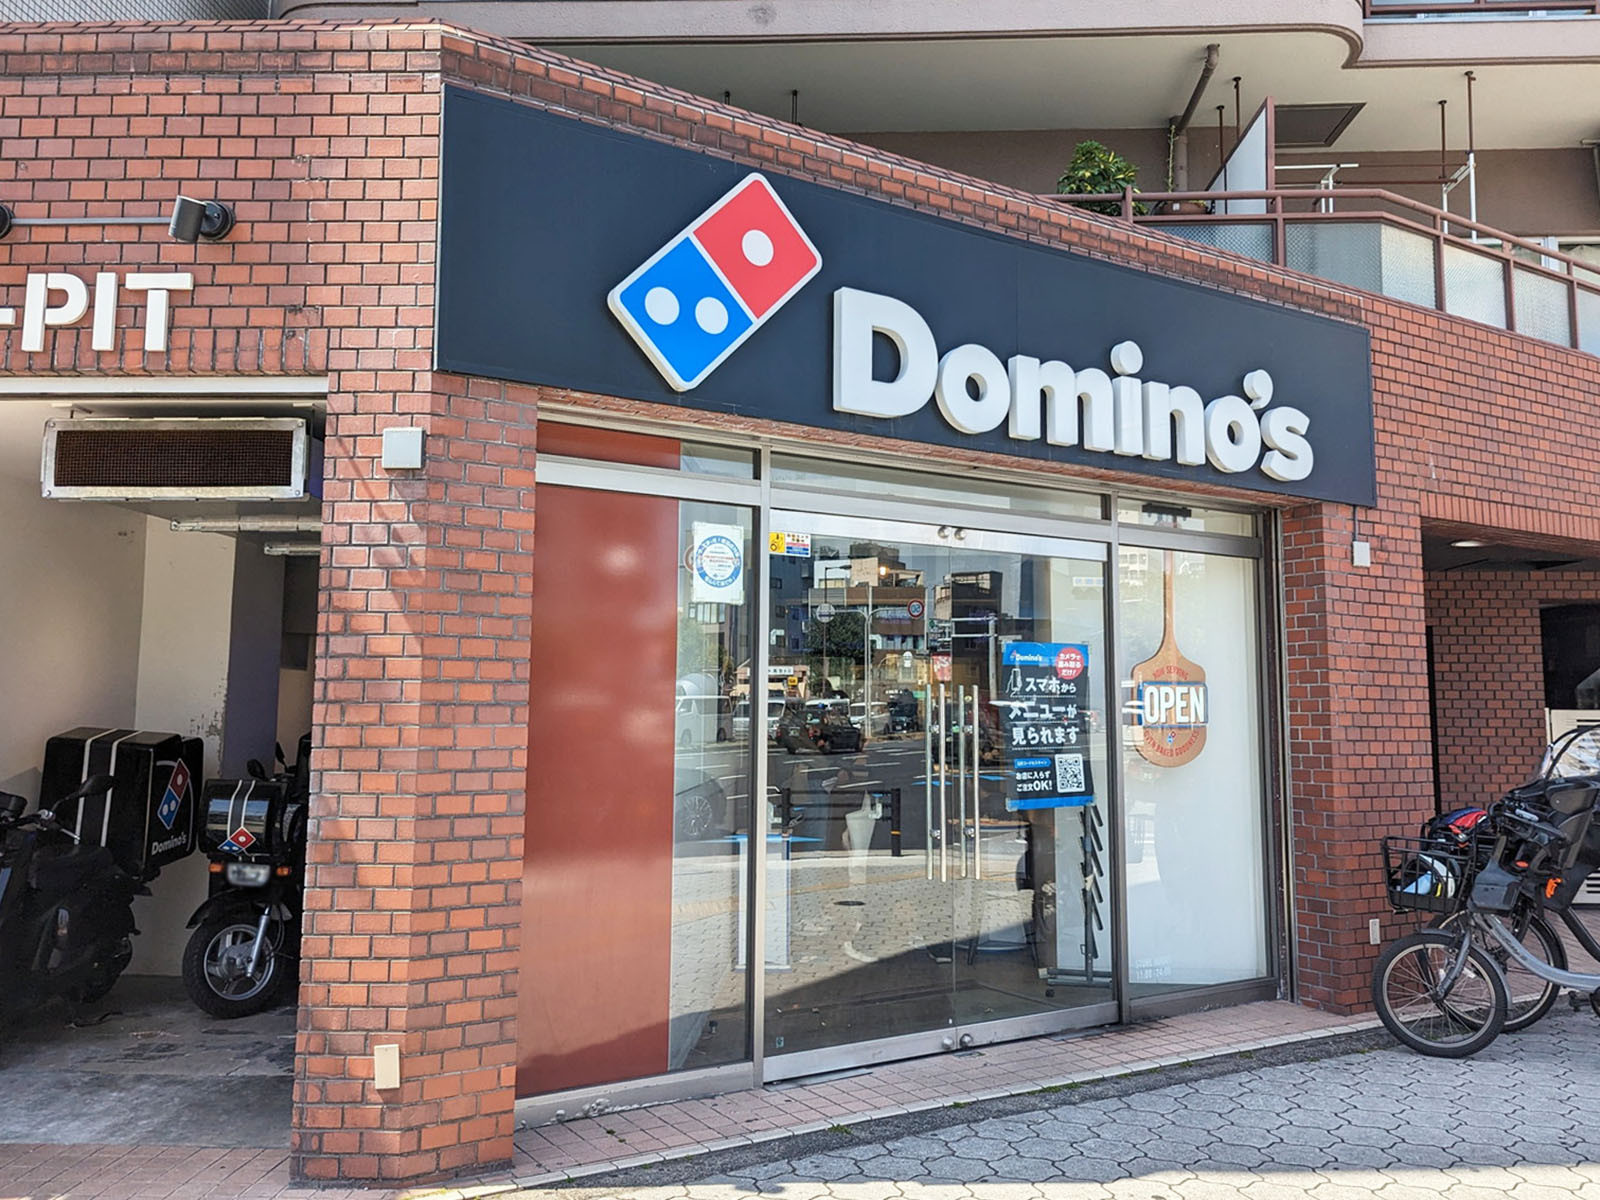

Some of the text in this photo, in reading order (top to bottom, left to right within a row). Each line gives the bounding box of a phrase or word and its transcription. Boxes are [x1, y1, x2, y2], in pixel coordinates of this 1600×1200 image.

[833, 287, 1314, 482] Domino's
[1025, 676, 1077, 694] スマホから
[1008, 703, 1078, 720] メニューが
[1144, 685, 1205, 724] OPEN
[1012, 726, 1080, 746] 見られます
[1016, 780, 1053, 792] ご注文OK!
[151, 832, 188, 856] Domino's
